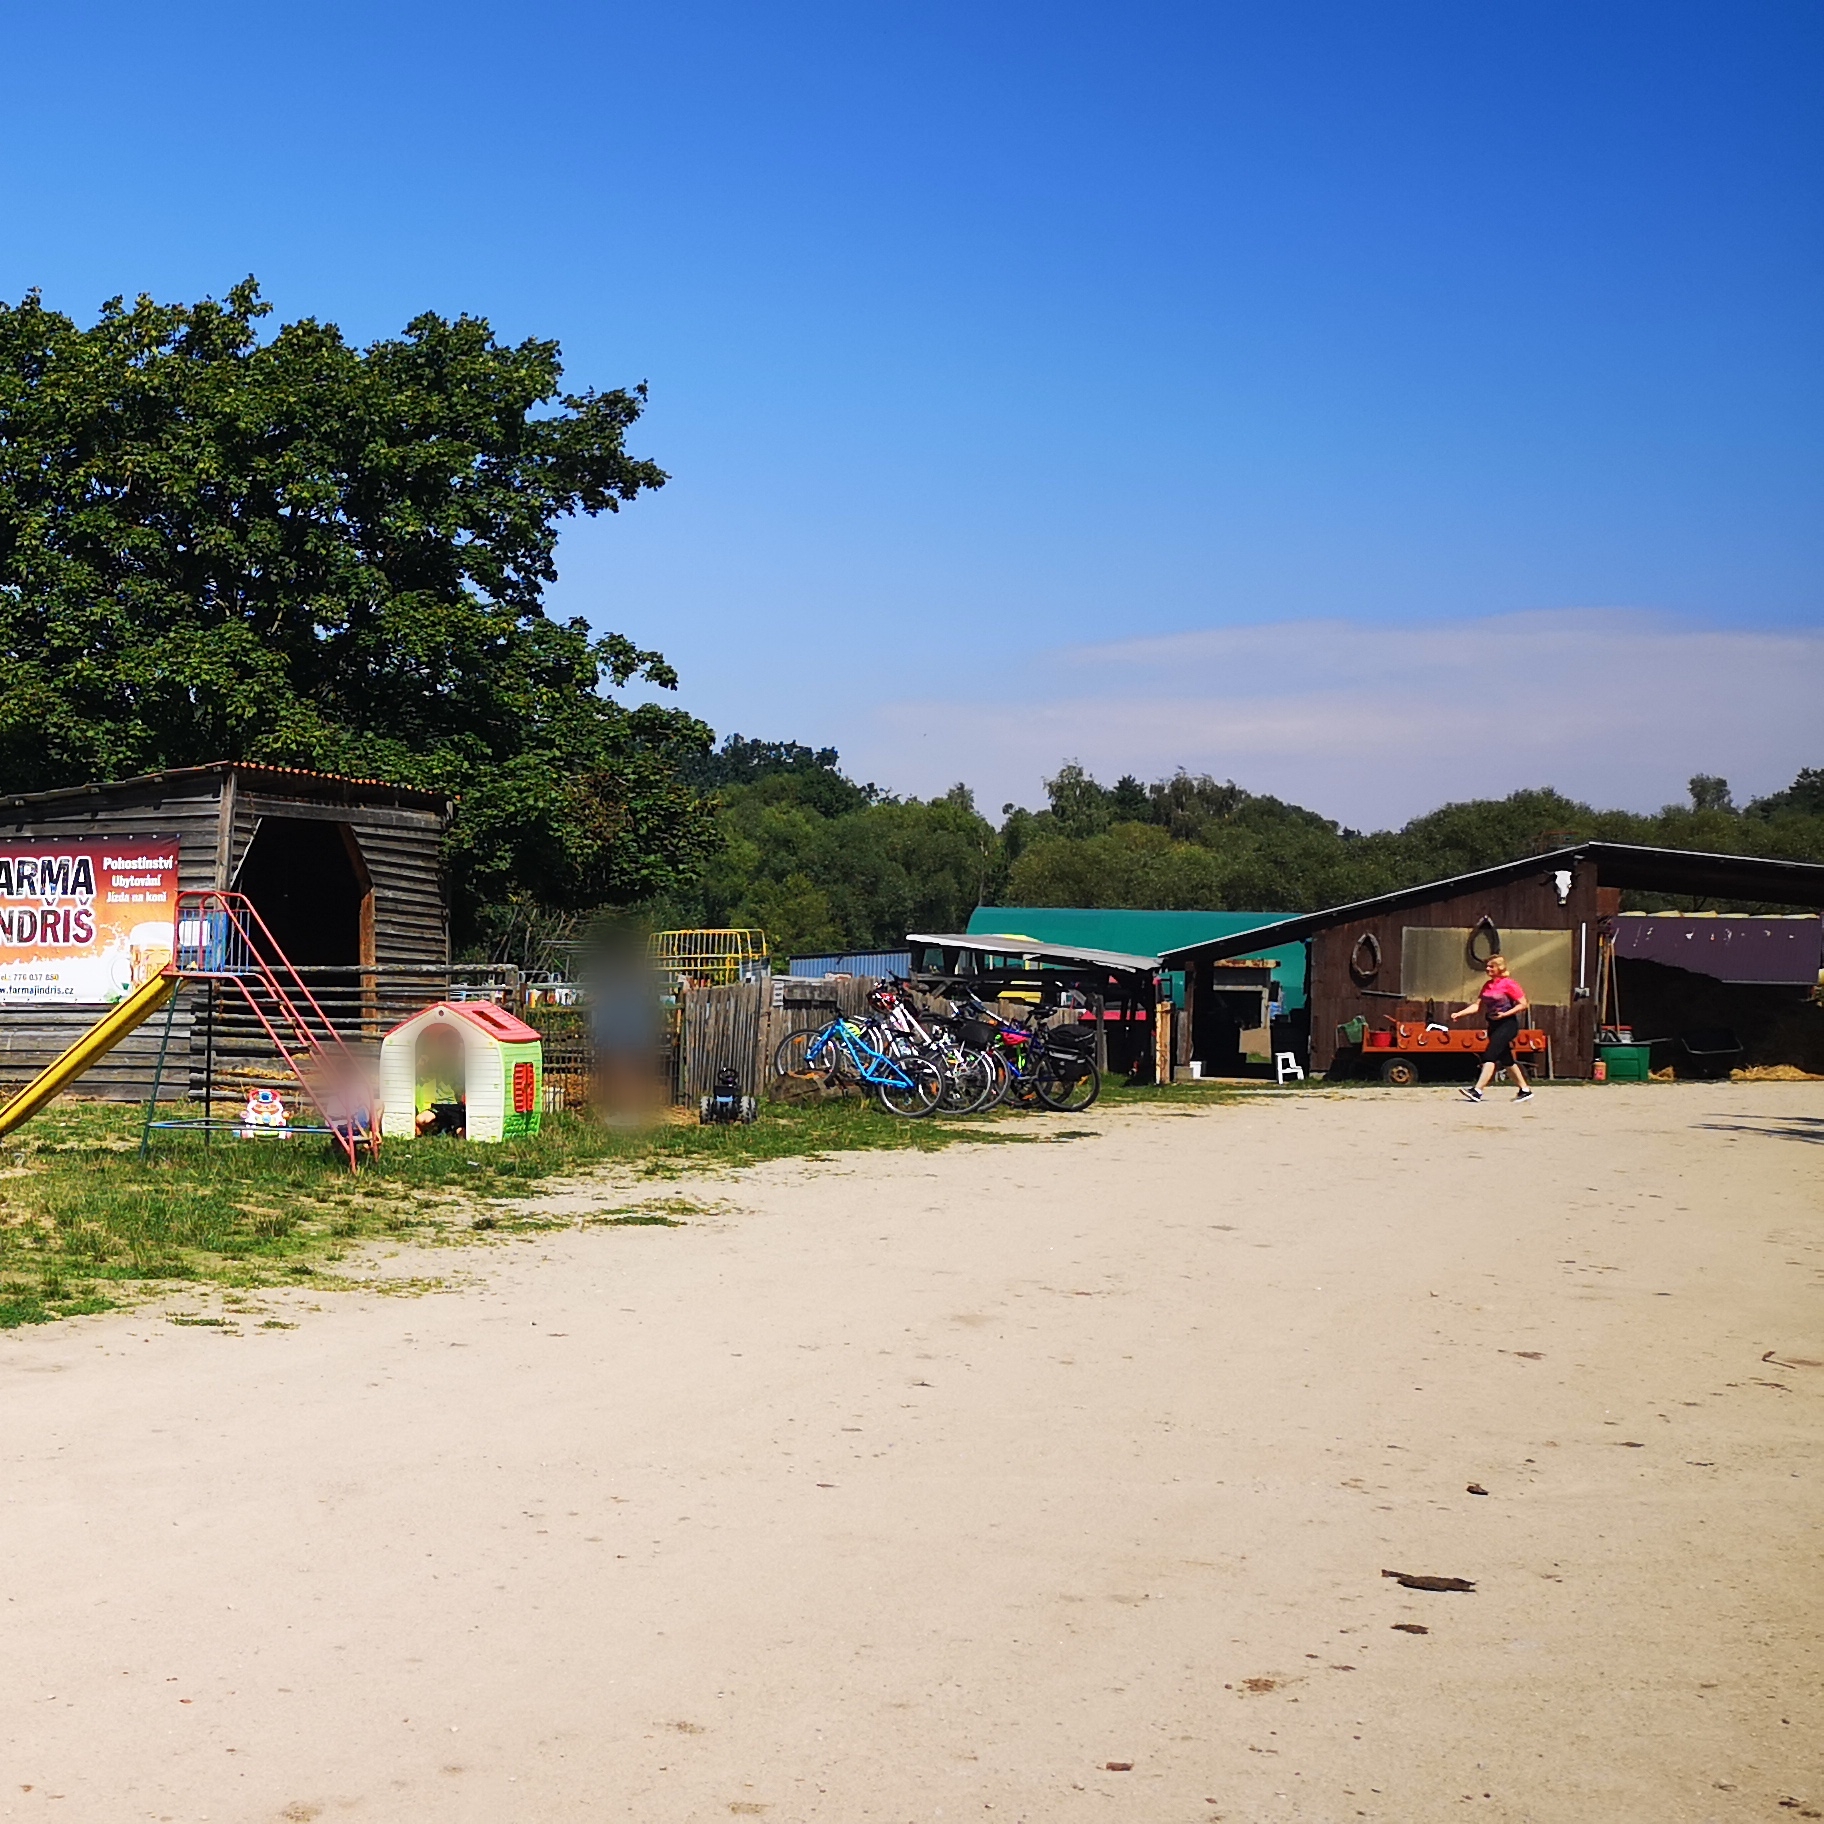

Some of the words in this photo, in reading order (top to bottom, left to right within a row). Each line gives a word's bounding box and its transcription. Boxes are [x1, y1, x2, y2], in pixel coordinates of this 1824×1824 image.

[102, 855, 174, 870] Pohostinství
[111, 873, 163, 888] Ubytování
[131, 893, 144, 903] na
